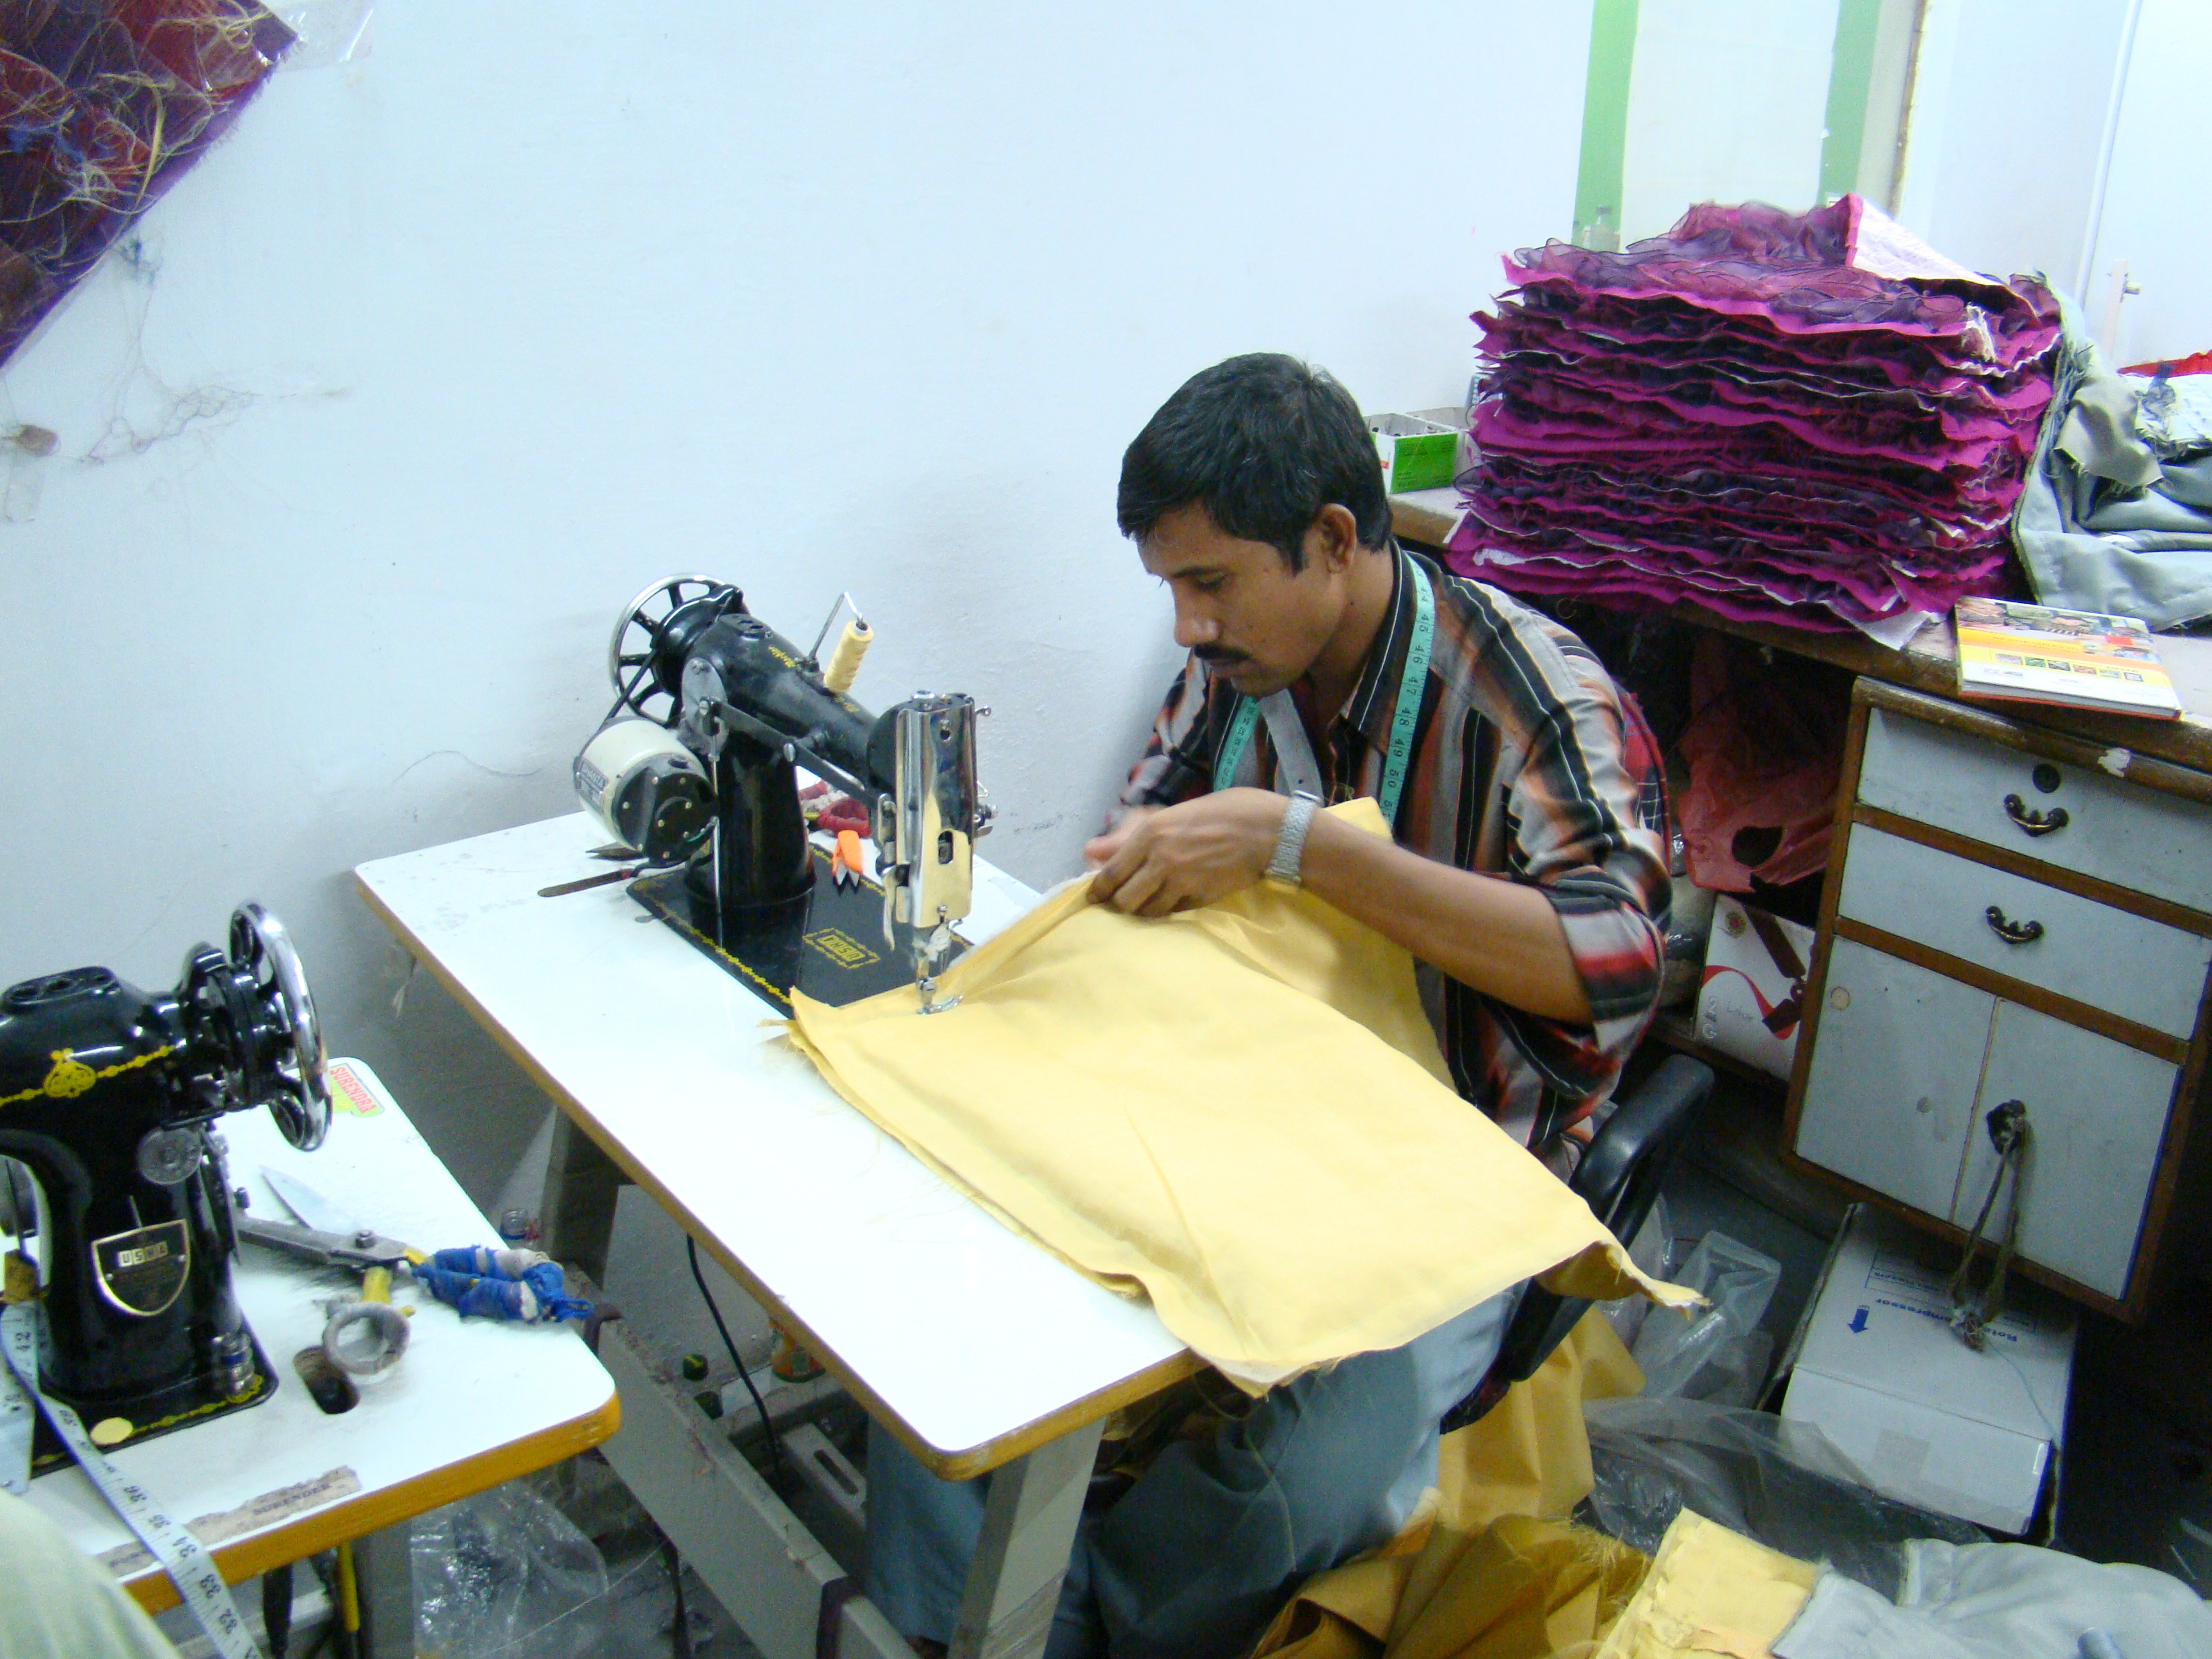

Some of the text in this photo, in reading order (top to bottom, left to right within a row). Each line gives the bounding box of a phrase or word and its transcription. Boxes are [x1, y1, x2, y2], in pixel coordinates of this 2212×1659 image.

[1419, 613, 1430, 634] 45
[1413, 644, 1425, 664] 46
[1406, 675, 1418, 696] 47
[1399, 706, 1412, 726] 48
[1393, 737, 1406, 758] 49
[1387, 769, 1400, 789] 50
[822, 936, 860, 959] USHA
[329, 1066, 377, 1114] SURENDRA
[1875, 1298, 1953, 1322] ompressor
[124, 1485, 148, 1502] 36
[148, 1514, 172, 1529] 35
[173, 1536, 198, 1558] 34
[200, 1573, 222, 1598] 33
[218, 1607, 237, 1634] 32
